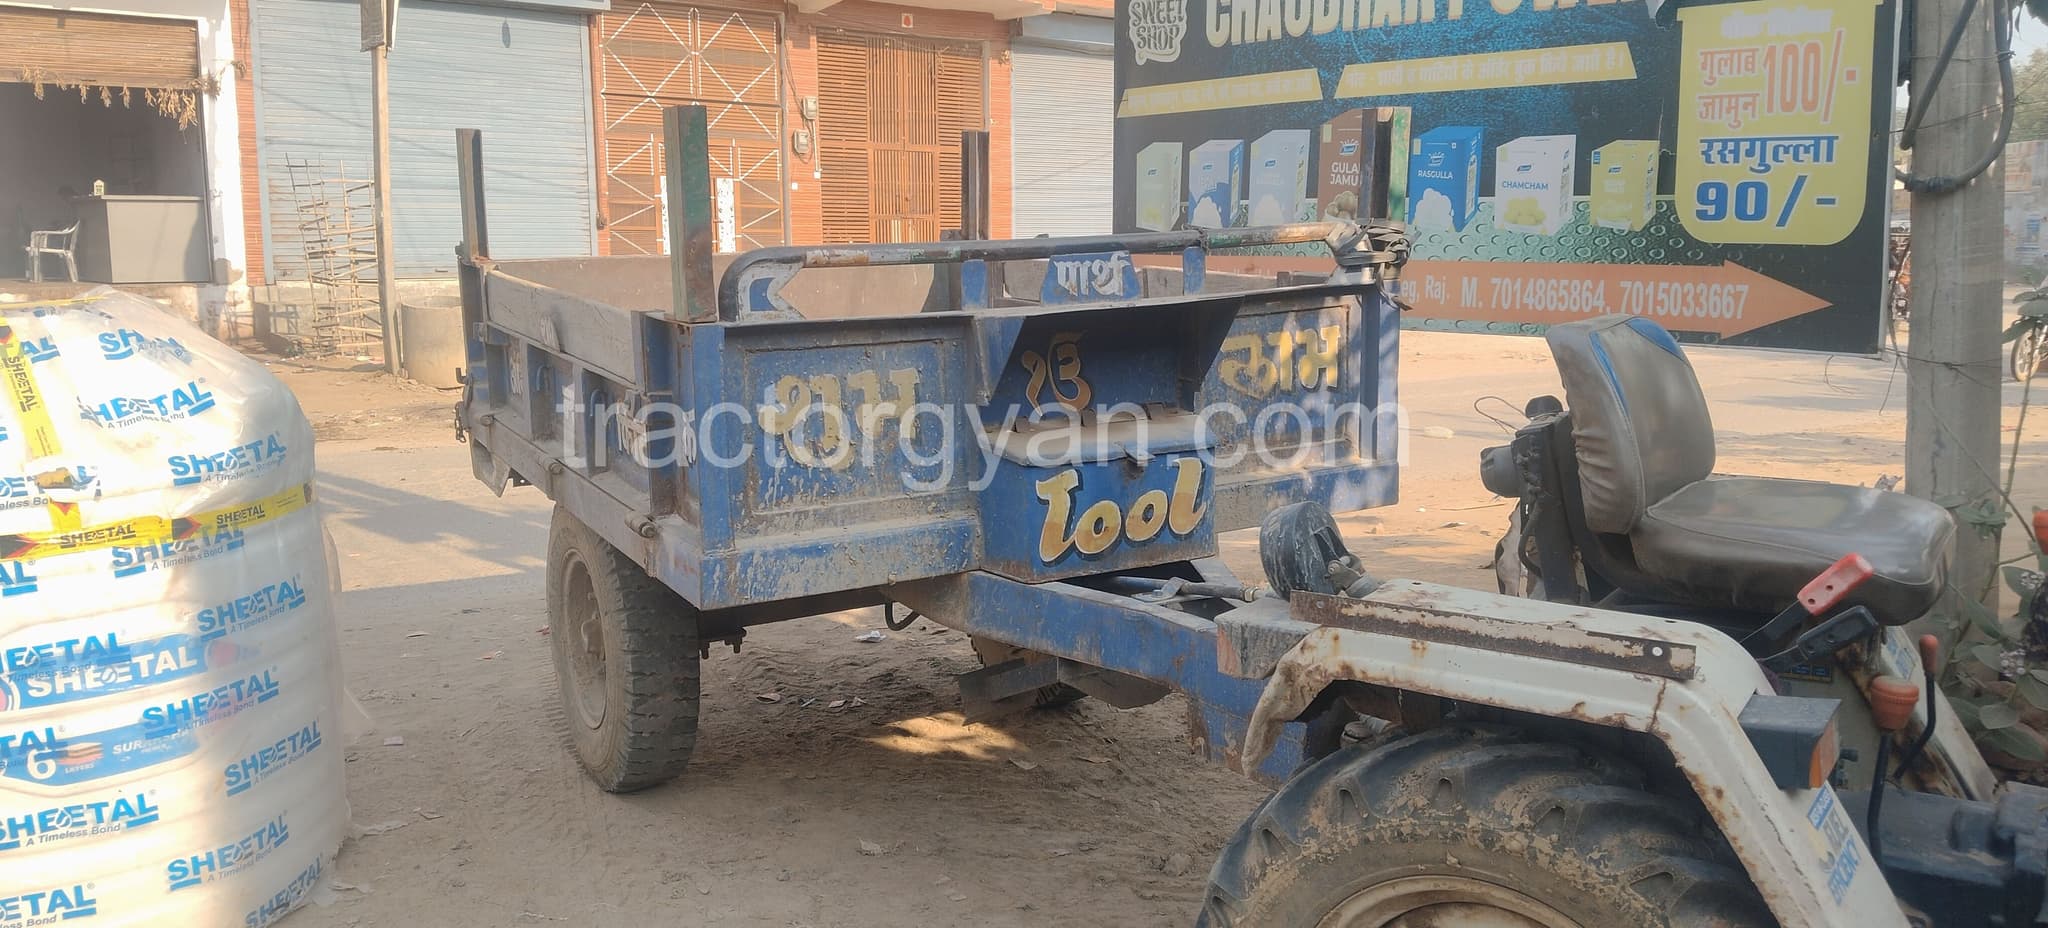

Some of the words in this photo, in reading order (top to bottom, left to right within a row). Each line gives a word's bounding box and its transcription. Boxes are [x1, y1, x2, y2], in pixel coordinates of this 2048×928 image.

[1136, 25, 1180, 50] SHOP
[1700, 47, 1760, 87] गुलाब
[1698, 93, 1761, 129] जामुन
[1331, 162, 1361, 174] GULA
[1417, 169, 1453, 180] RASGULLA
[1700, 136, 1839, 173] रसगुल्ला
[1502, 180, 1549, 191] CHAMCHAM
[1695, 175, 1837, 229] 90/-
[1053, 250, 1131, 297] पार्थ
[1425, 275, 1449, 305] Raj.
[1461, 276, 1483, 309] M.
[1490, 277, 1612, 314] 7014865864,
[1620, 280, 1749, 320] 7015033667
[1219, 324, 1341, 399] लाभ
[216, 504, 265, 525] SHEETAL
[1036, 457, 1207, 563] Tool
[60, 524, 136, 546] SHEETAL
[197, 576, 305, 632] SHEETAL
[0, 632, 131, 674] EETAL
[28, 646, 197, 698] SHEETAL
[142, 669, 280, 730] SHEETAL
[27, 747, 57, 780] 6
[224, 720, 321, 787] SHEETAL
[26, 838, 34, 847] A
[38, 827, 88, 844] Timeless
[91, 823, 122, 836] Bond
[167, 814, 288, 882] SHEETAL
[27, 914, 57, 927] Bond
